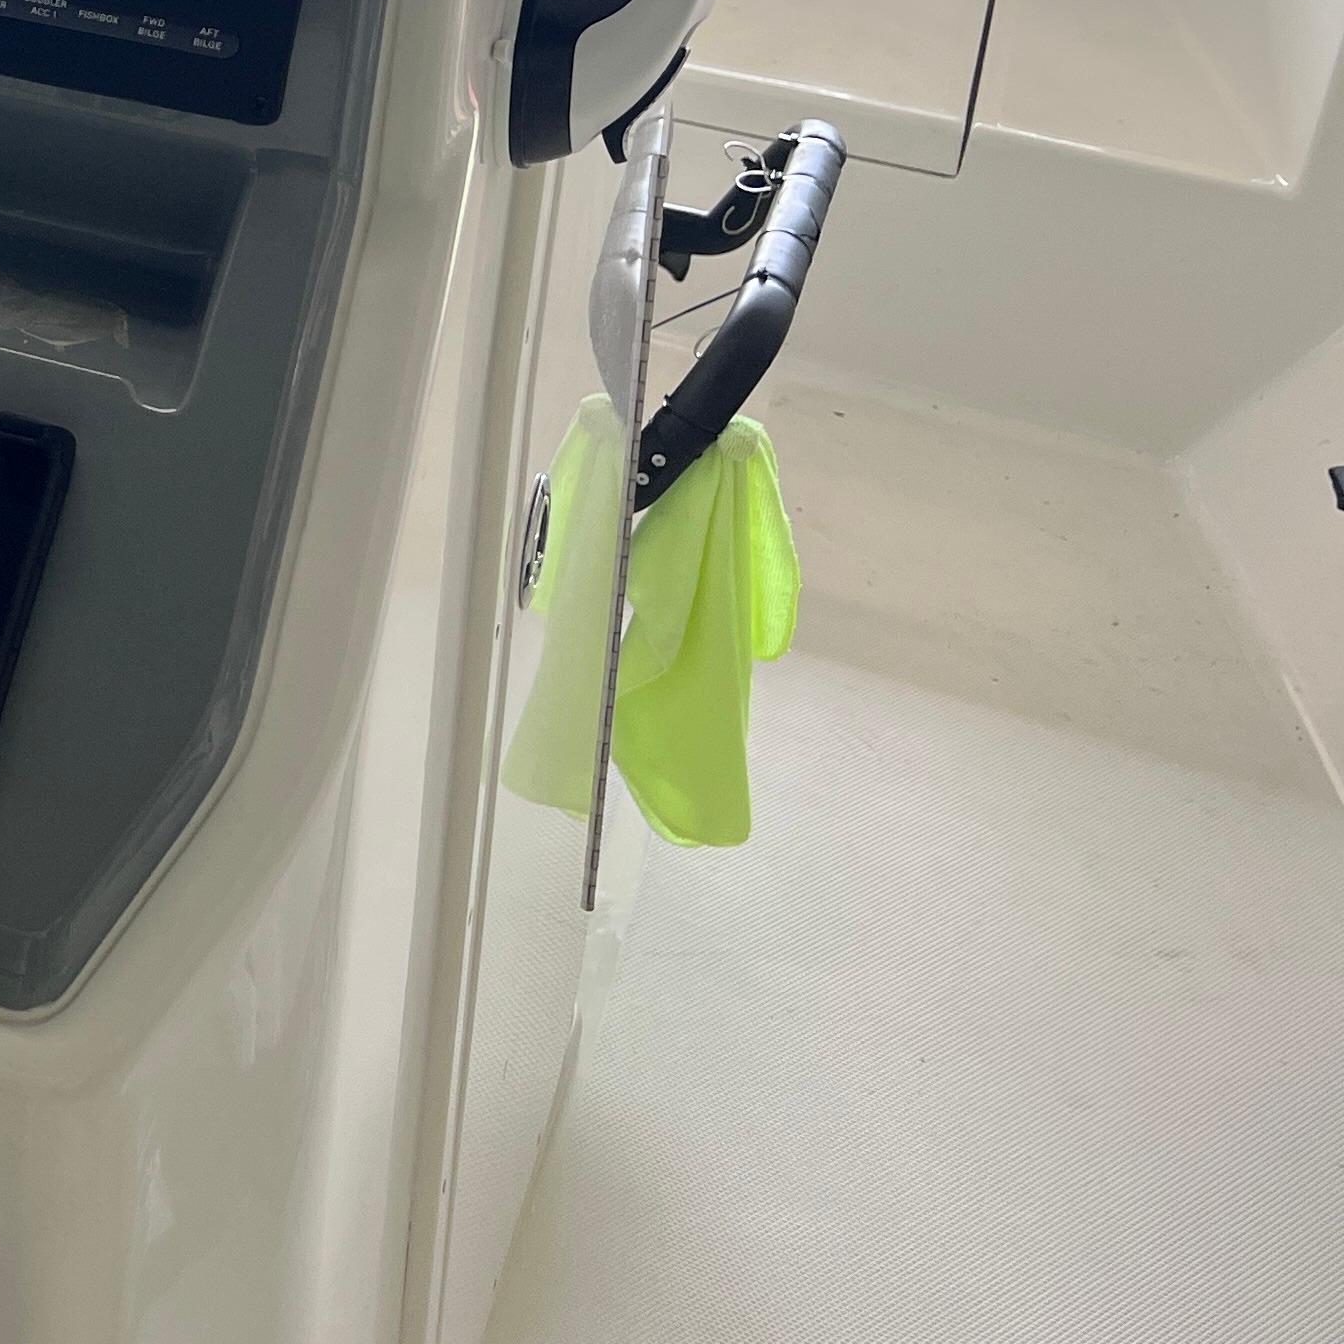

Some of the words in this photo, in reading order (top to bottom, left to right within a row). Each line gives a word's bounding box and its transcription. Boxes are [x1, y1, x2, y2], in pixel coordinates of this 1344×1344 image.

[78, 9, 120, 25] FISHBOX
[142, 15, 167, 29] FWD
[137, 26, 167, 41] BILGE
[199, 26, 221, 39] AFT
[192, 37, 224, 51] BILGE
